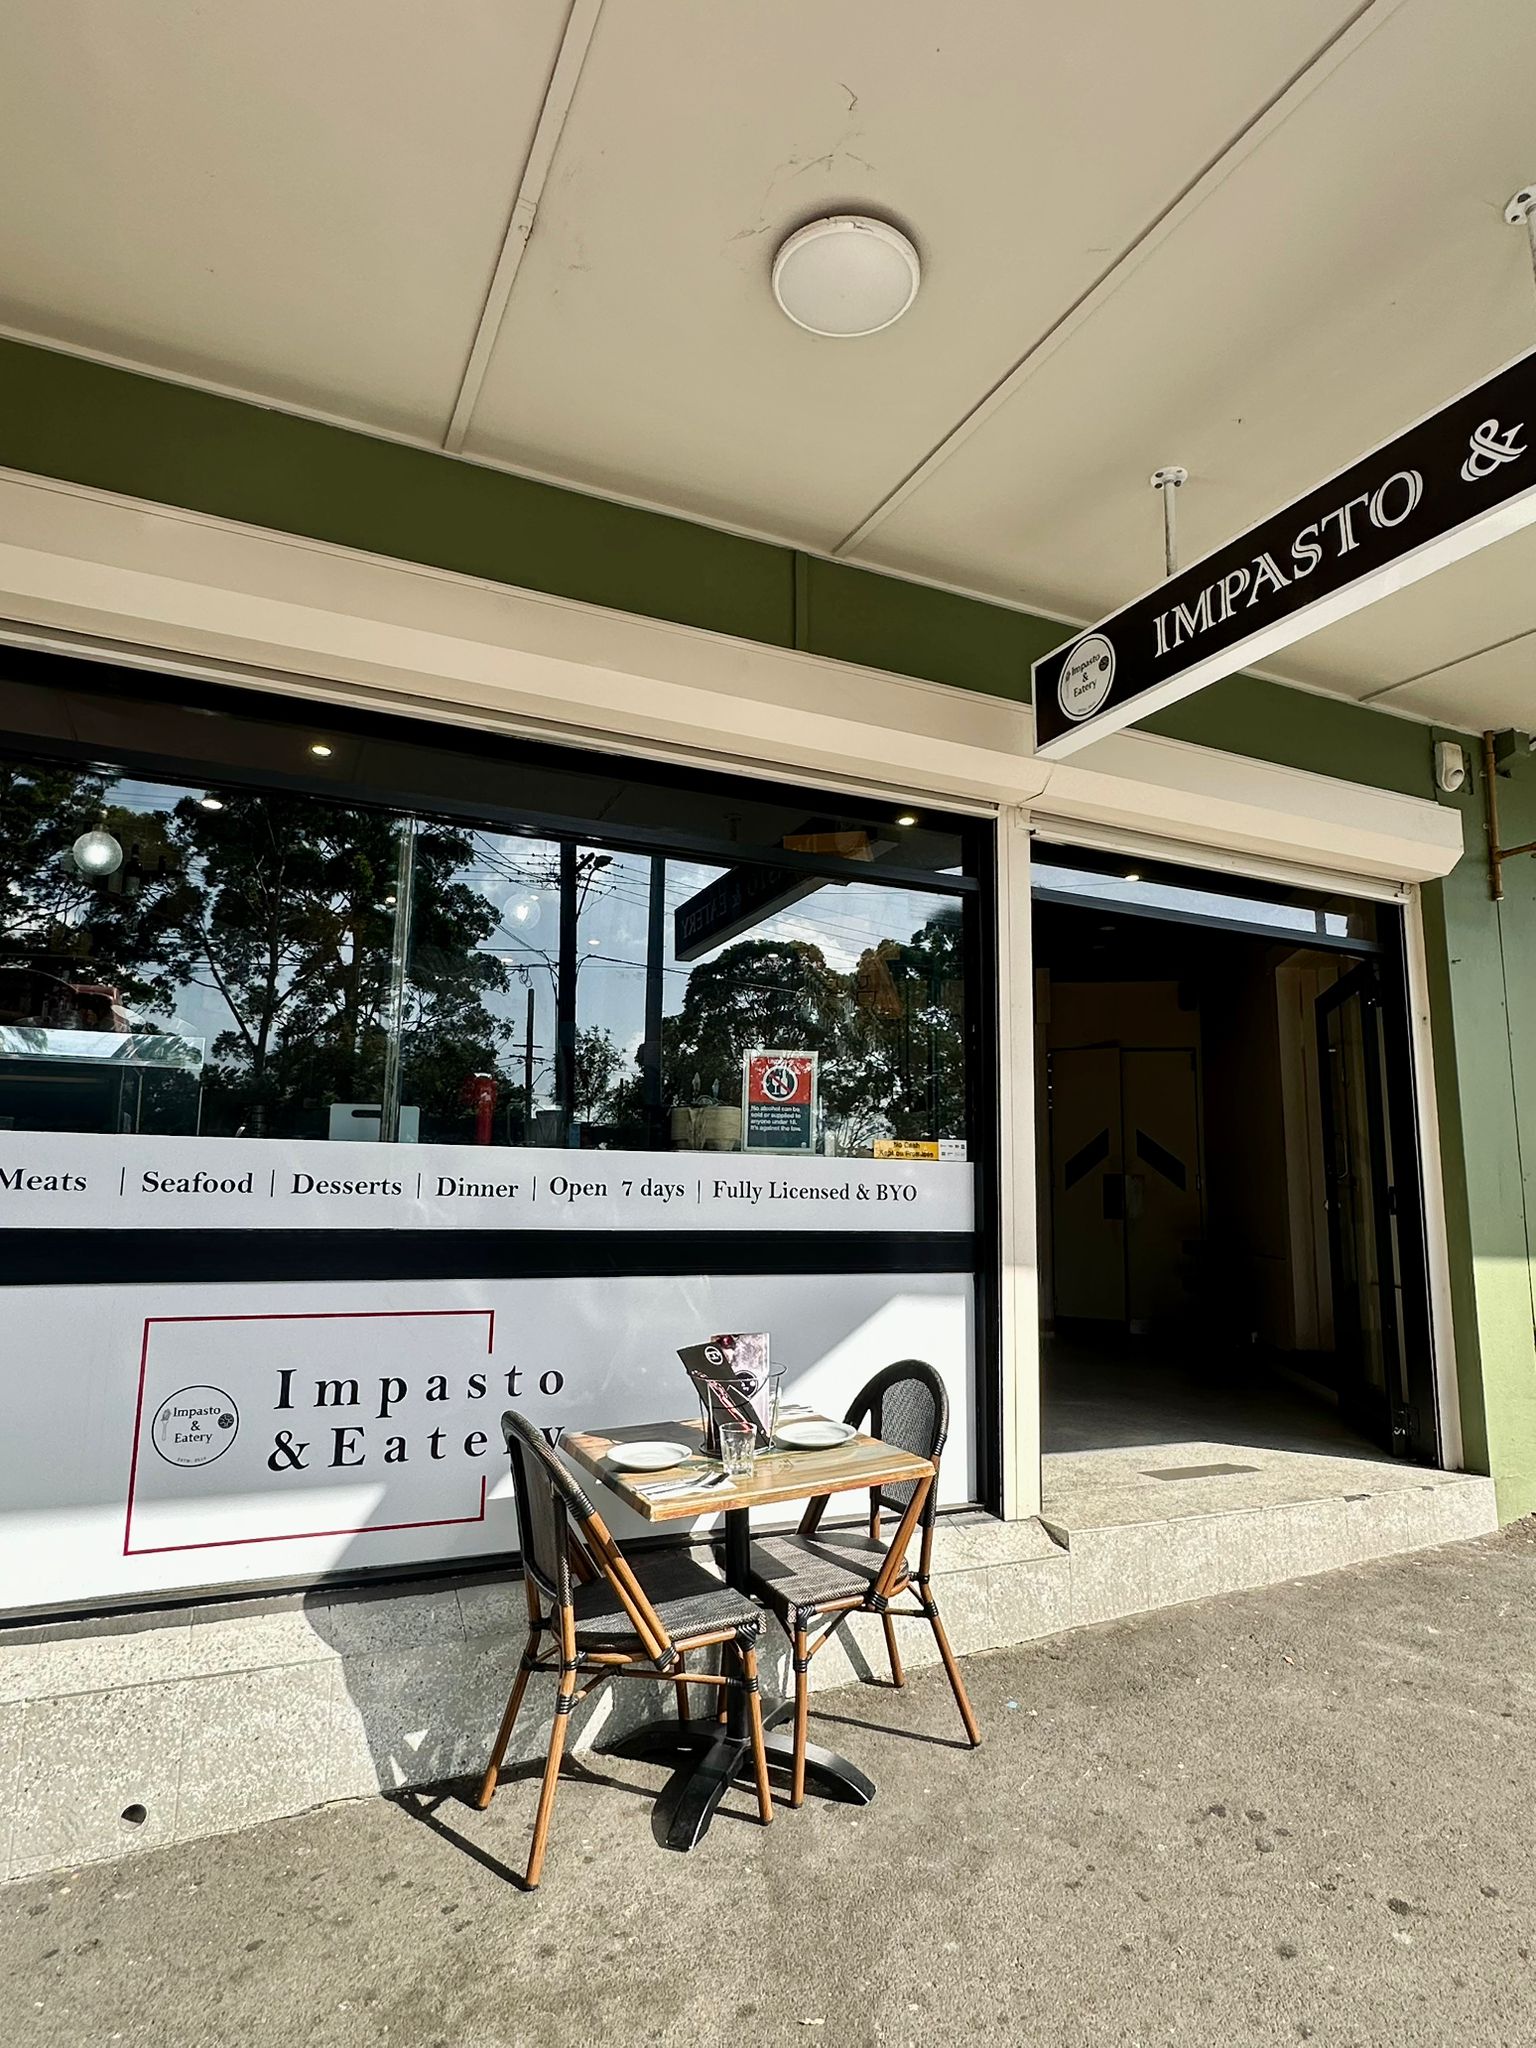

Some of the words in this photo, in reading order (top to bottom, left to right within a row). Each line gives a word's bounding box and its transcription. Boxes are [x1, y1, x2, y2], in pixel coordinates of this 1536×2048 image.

[1153, 469, 1424, 659] IMPASTO
[1460, 418, 1528, 483] &
[1071, 653, 1101, 676] Impasto
[1073, 678, 1098, 698] Eatery
[893, 1141, 903, 1149] No
[904, 1141, 921, 1149] Cash
[0, 1168, 87, 1192] Meats
[141, 1170, 254, 1194] Seafood
[290, 1173, 402, 1196] Desserts
[435, 1177, 519, 1198] Dinner
[549, 1176, 608, 1202] Open
[621, 1180, 633, 1197] 7
[640, 1178, 685, 1203] days
[712, 1180, 763, 1204] Fully
[768, 1180, 850, 1200] Licensed
[855, 1184, 871, 1201] &
[876, 1184, 918, 1201] BYO
[273, 1364, 564, 1419] Impasto
[173, 1406, 221, 1419] Impasto
[190, 1420, 200, 1432] &
[174, 1432, 213, 1444] Eatery
